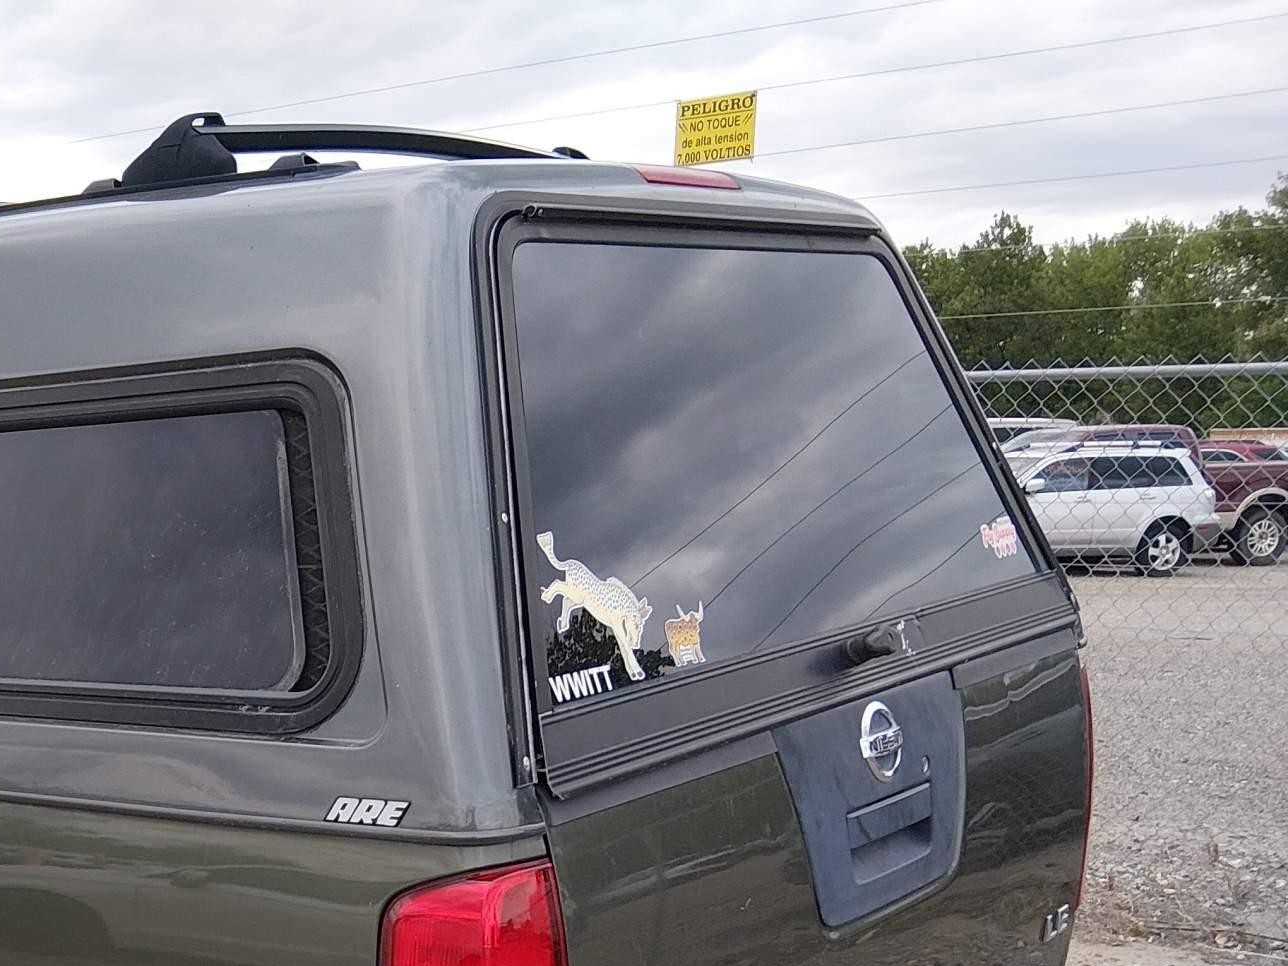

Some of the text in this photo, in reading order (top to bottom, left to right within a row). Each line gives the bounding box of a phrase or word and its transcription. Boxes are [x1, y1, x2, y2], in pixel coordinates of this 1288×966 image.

[680, 96, 753, 117] PELIGRO
[689, 115, 740, 132] NO TOQUE
[681, 131, 749, 149] de alta tension
[704, 144, 751, 161] VOLTIOS
[548, 664, 613, 703] WWITT
[323, 796, 411, 827] ARE
[1042, 903, 1069, 943] LE
